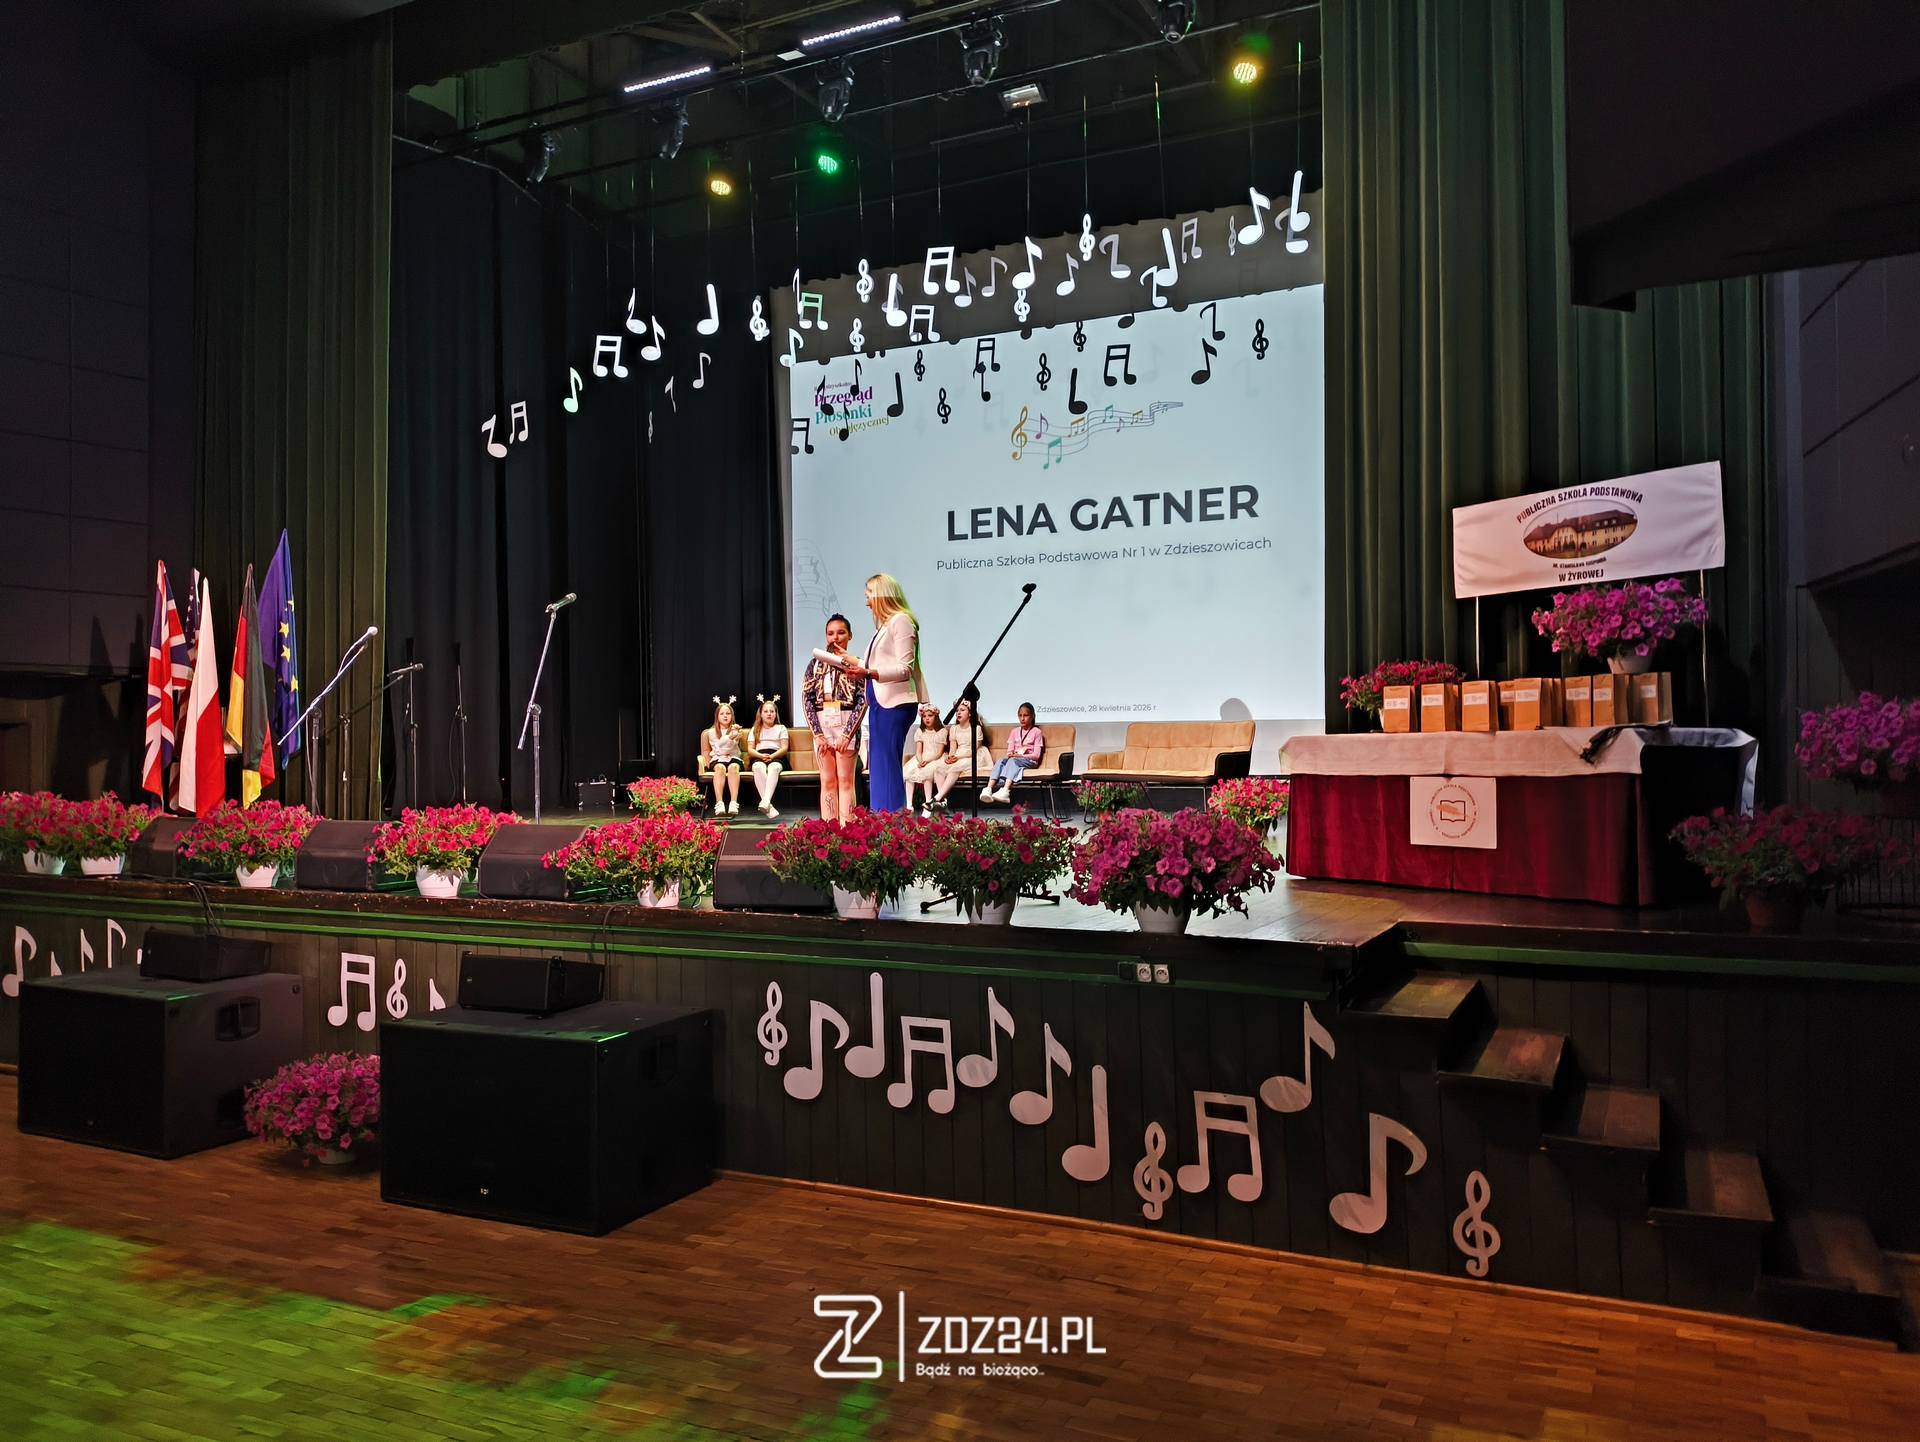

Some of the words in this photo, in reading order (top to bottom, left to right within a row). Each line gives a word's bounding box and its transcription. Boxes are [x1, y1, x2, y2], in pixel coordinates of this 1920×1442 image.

[947, 503, 1058, 541] LENA
[1070, 484, 1260, 532] GATNER
[1516, 495, 1556, 523] PUBLICZNA
[1589, 487, 1644, 504] PODSTAWOWA
[936, 556, 993, 571] Publiczna
[996, 553, 1035, 567] Szkoła
[1038, 549, 1119, 564] Podstawowa
[1122, 547, 1138, 558] Nr
[1140, 546, 1146, 557] 1
[1149, 547, 1161, 556] w
[1164, 537, 1272, 556] Zdzieszowicach
[1558, 573, 1567, 582] W
[1568, 569, 1604, 582] ŻYROWEJ
[1099, 704, 1131, 712] kwietnia
